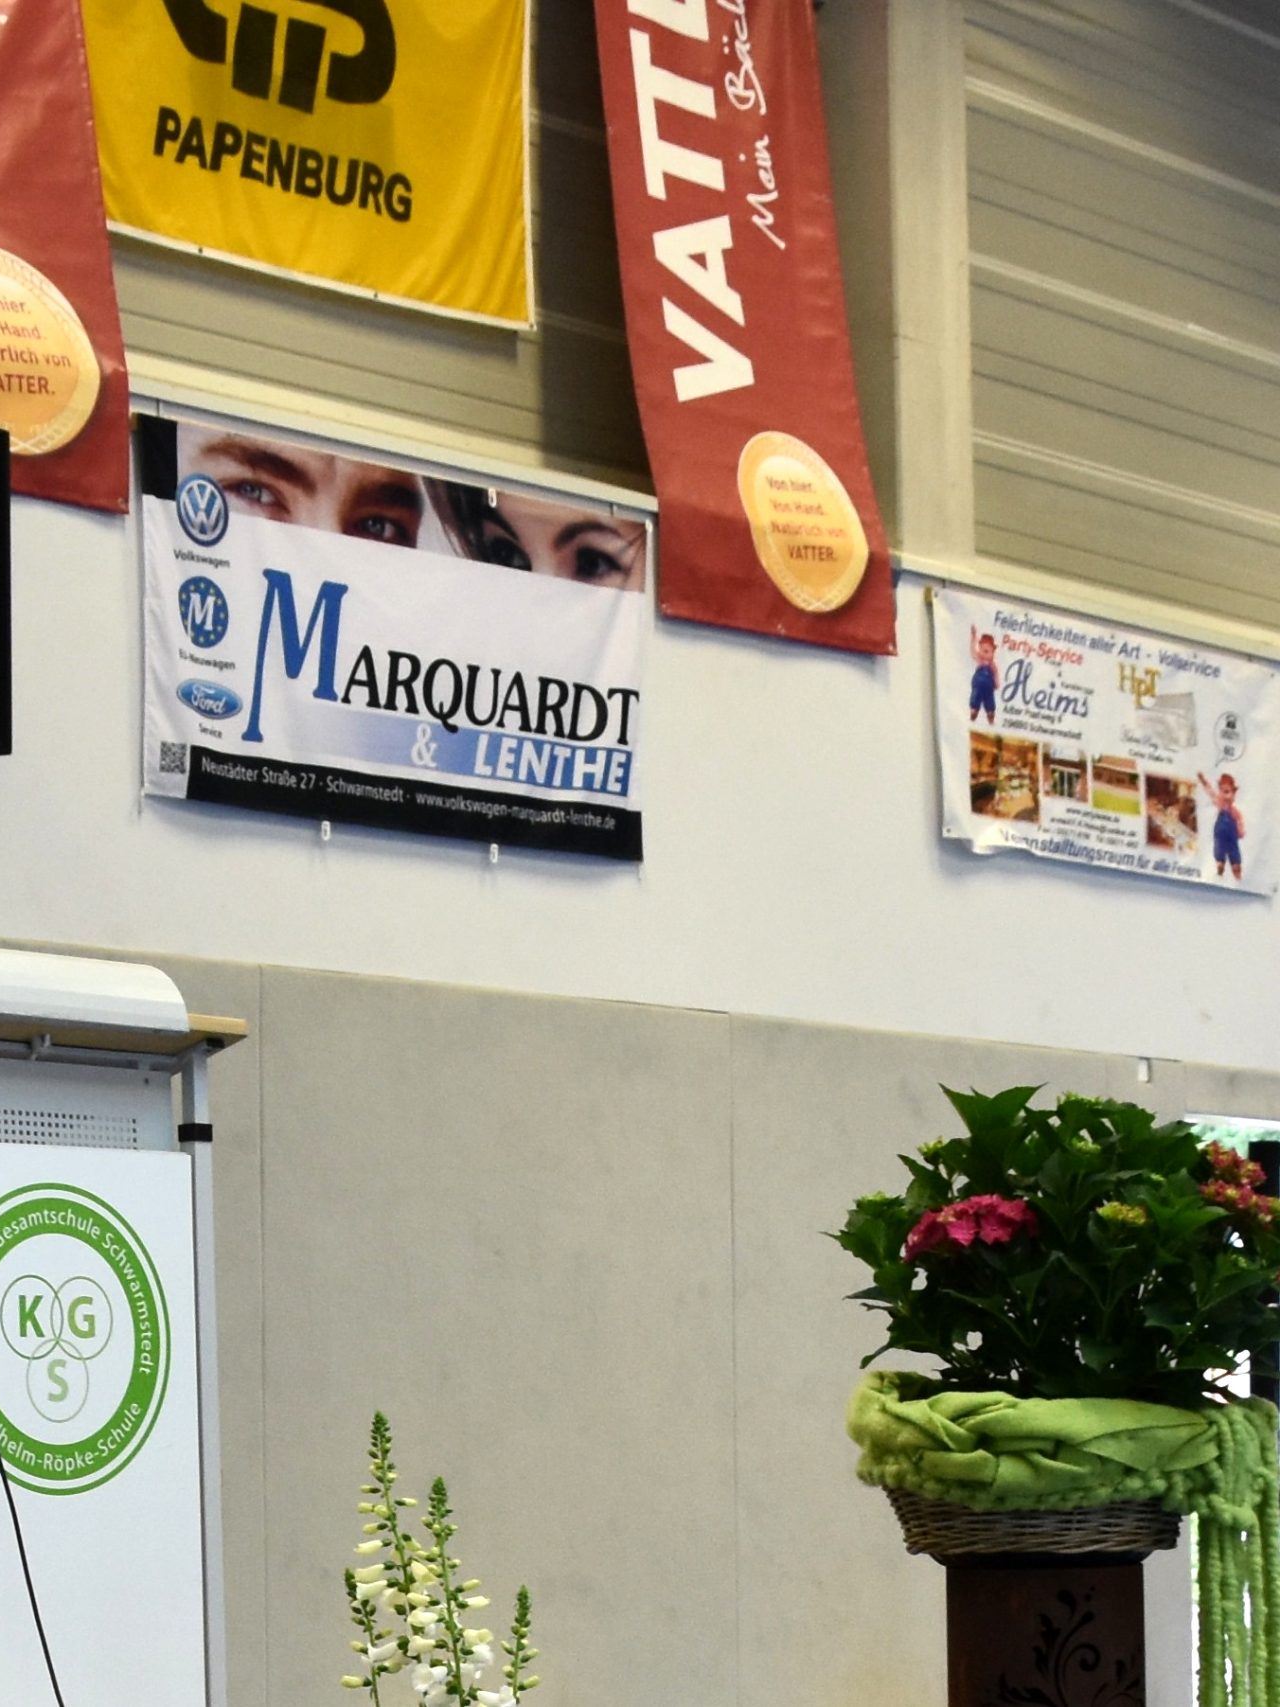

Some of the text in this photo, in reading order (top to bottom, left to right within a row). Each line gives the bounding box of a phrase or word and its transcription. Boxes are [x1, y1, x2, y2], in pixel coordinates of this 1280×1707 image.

[153, 105, 413, 224] PAPENBURG
[740, 135, 785, 250] Mein
[40, 353, 71, 367] von
[173, 549, 231, 568] Volkswagen
[788, 544, 838, 562] VATTER.
[187, 592, 216, 640] M
[994, 610, 1087, 646] Feierlichkeiten
[1089, 636, 1117, 653] aller
[1118, 641, 1141, 660] Art
[240, 567, 641, 746] MARQUARDT
[1002, 634, 1084, 666] Party-Service
[191, 683, 226, 714] Ford
[1001, 658, 1089, 718] Heims
[410, 725, 629, 793] & LENTHE
[201, 756, 616, 830] Neustädter Straße 27 Schwarmstedt www.volkswagen-marquardt-lenthe.de
[17, 1294, 96, 1339] K G
[102, 1232, 154, 1374] Schwarmstedt
[47, 1359, 69, 1402] S
